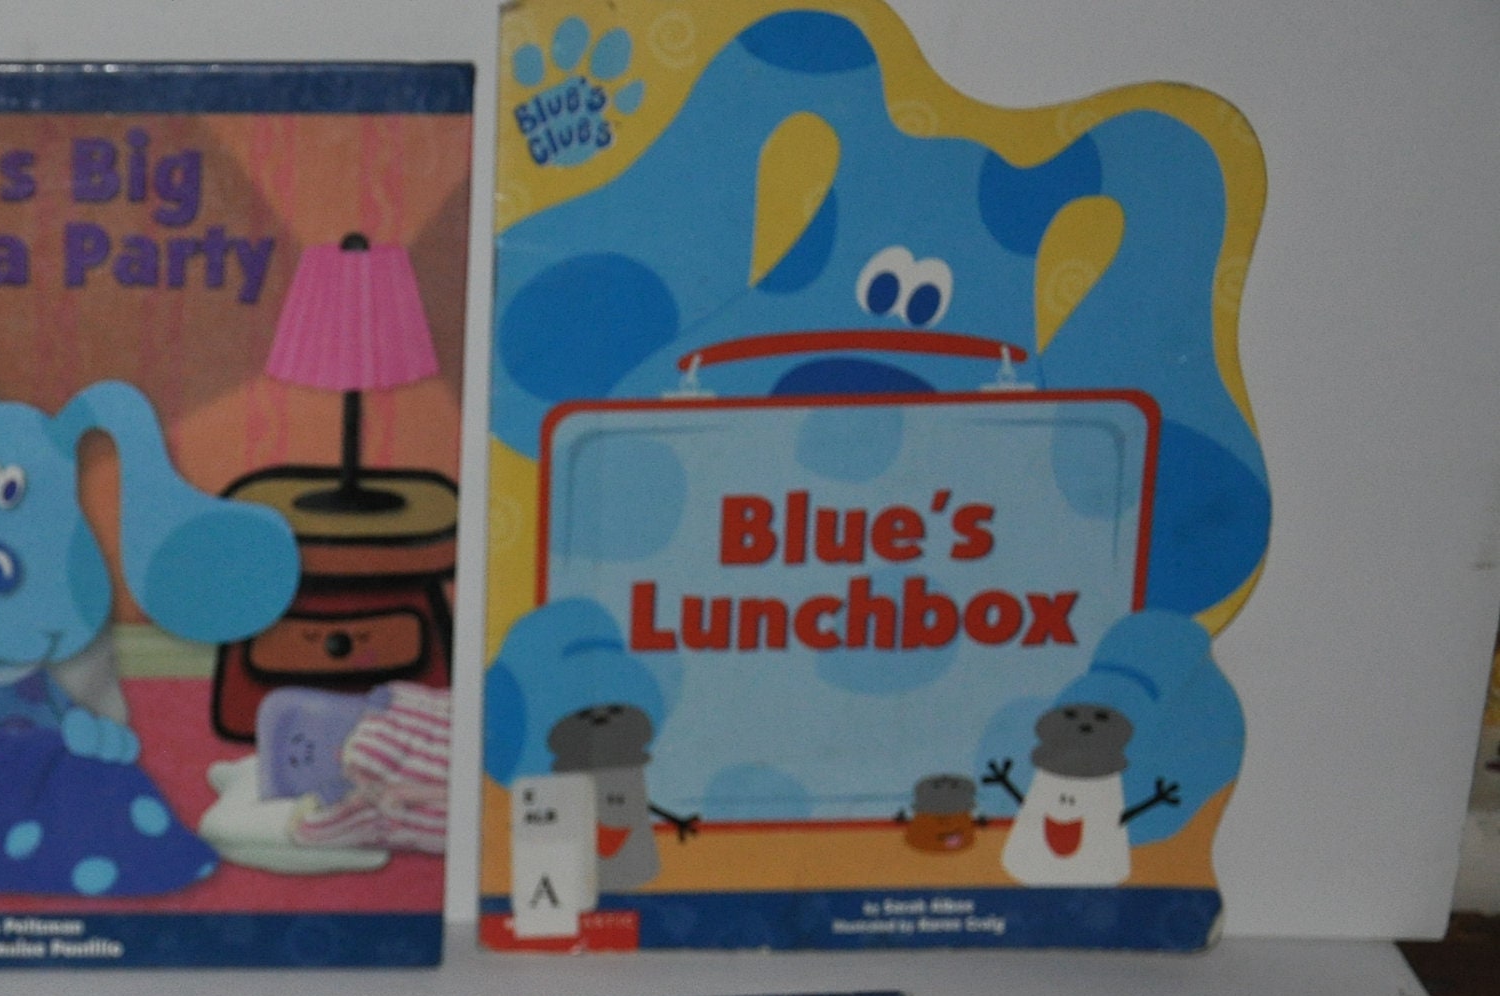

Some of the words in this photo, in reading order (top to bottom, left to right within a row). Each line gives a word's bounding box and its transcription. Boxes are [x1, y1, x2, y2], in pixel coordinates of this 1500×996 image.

[513, 76, 607, 136] Blue's
[527, 117, 613, 166] Clues
[71, 128, 204, 227] Big
[62, 222, 275, 305] Party
[719, 490, 995, 565] Blue's
[630, 576, 1080, 652] Lunchbox
[530, 875, 560, 909] A
